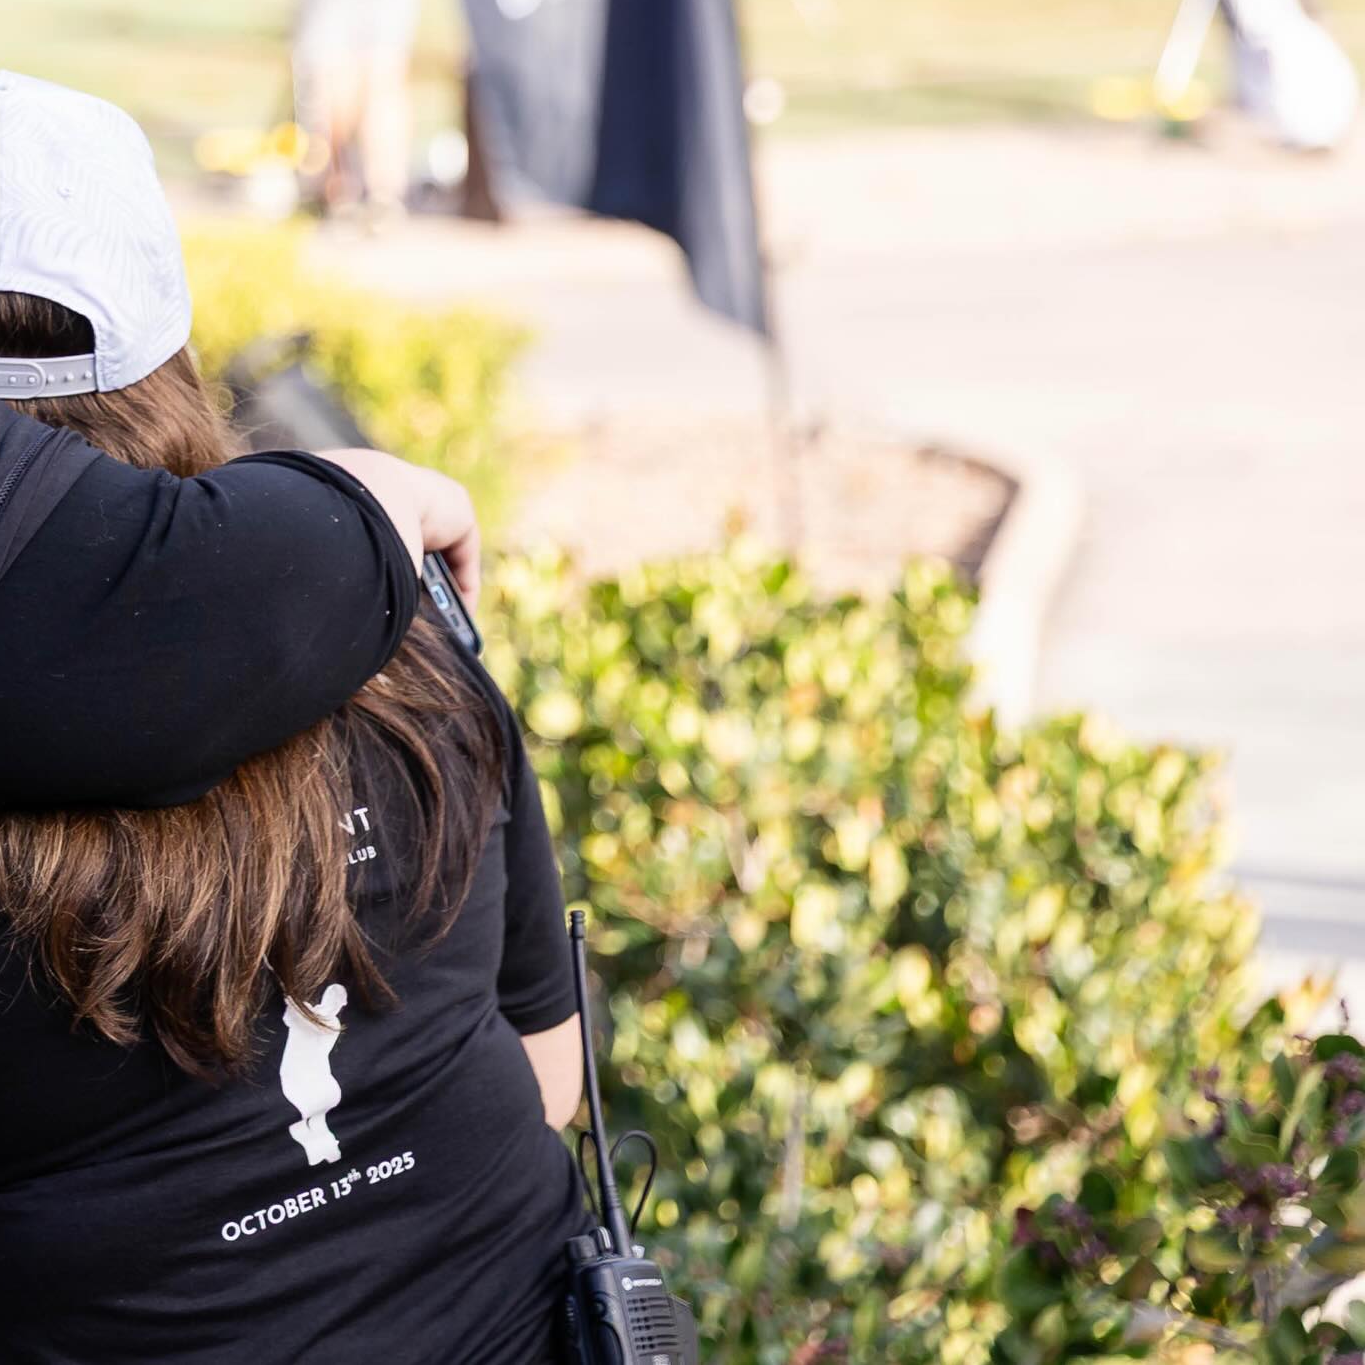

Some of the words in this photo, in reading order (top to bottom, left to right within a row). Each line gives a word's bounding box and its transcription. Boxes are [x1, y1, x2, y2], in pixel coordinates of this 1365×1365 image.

[345, 845, 378, 866] LUB
[221, 1187, 328, 1242] OCTOBER
[330, 1168, 362, 1199] 13th
[366, 1151, 416, 1185] 2025
